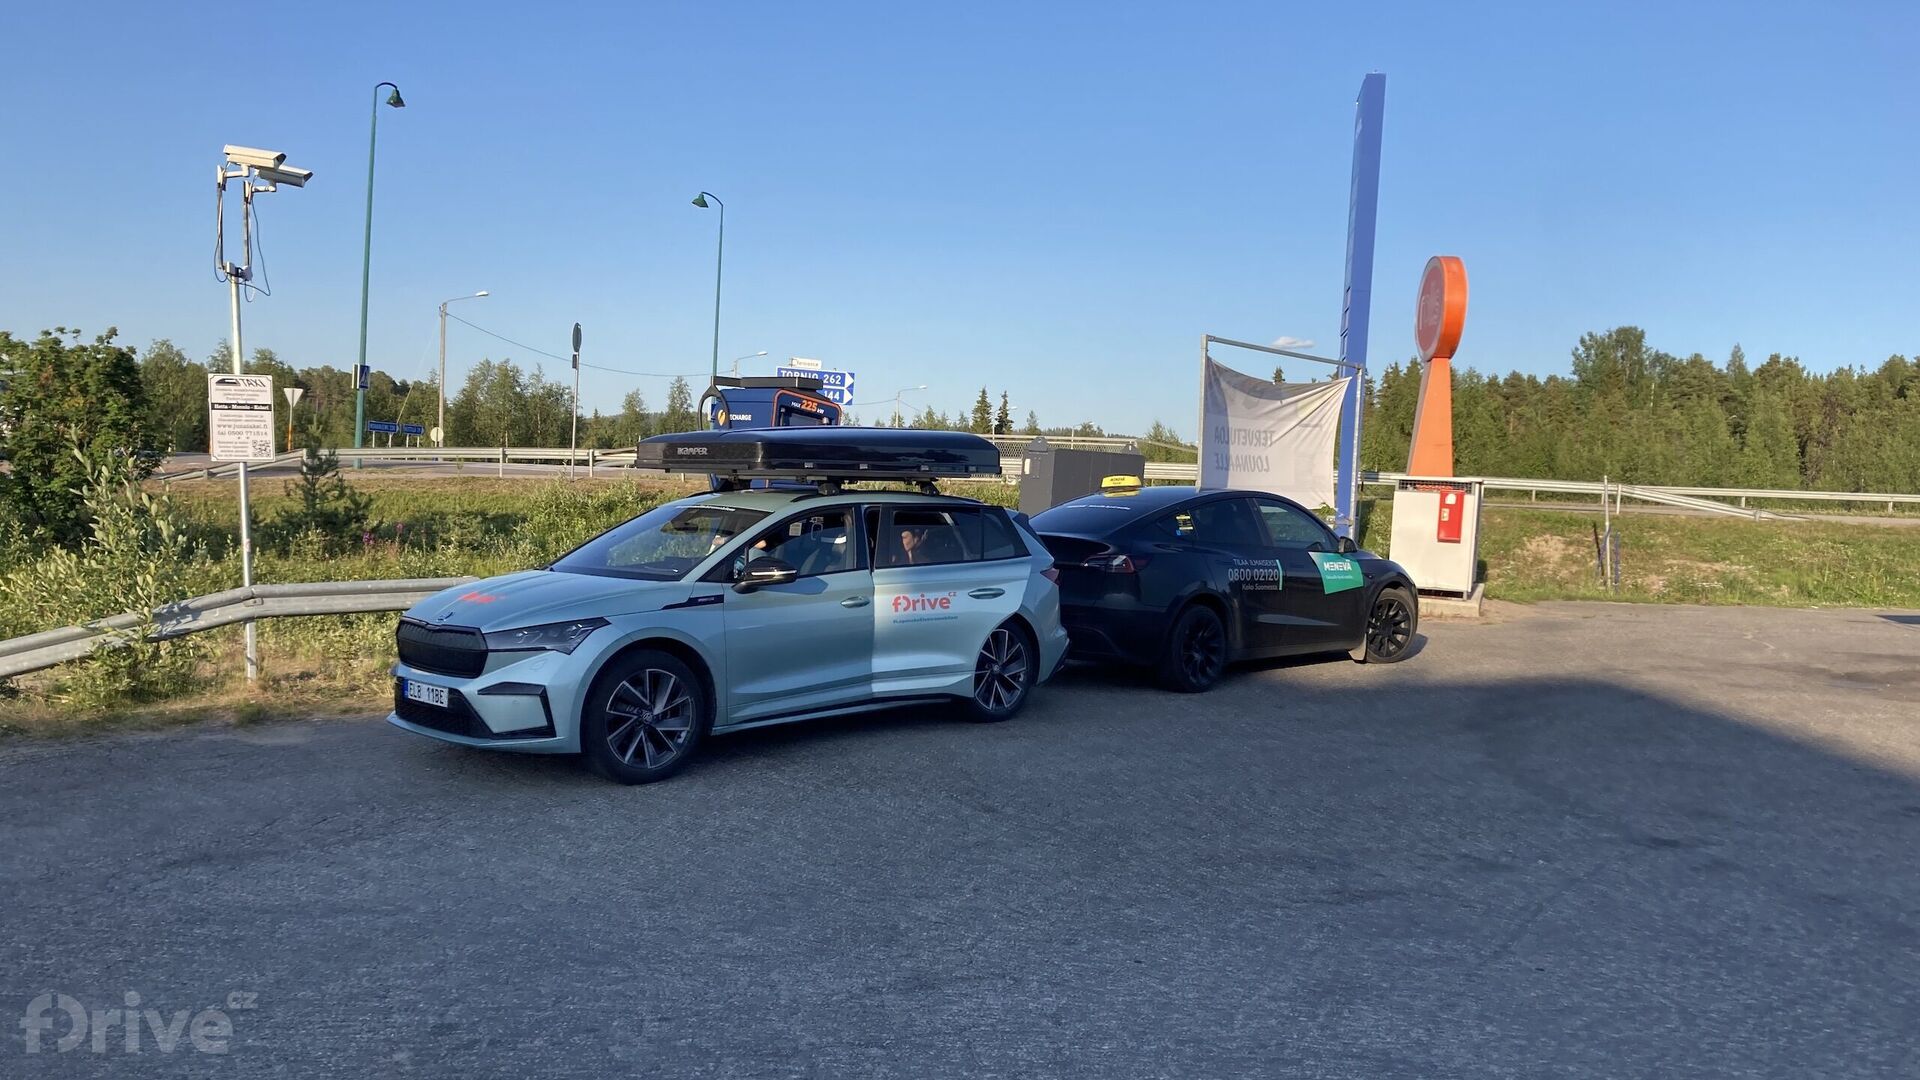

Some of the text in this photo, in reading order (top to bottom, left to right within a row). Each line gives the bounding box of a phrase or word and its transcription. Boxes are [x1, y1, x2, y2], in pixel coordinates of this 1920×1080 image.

[239, 378, 266, 387] TAXI
[823, 374, 841, 385] 262
[823, 390, 840, 401] 144
[801, 399, 818, 412] 225
[1228, 568, 1279, 581] 0800 02120
